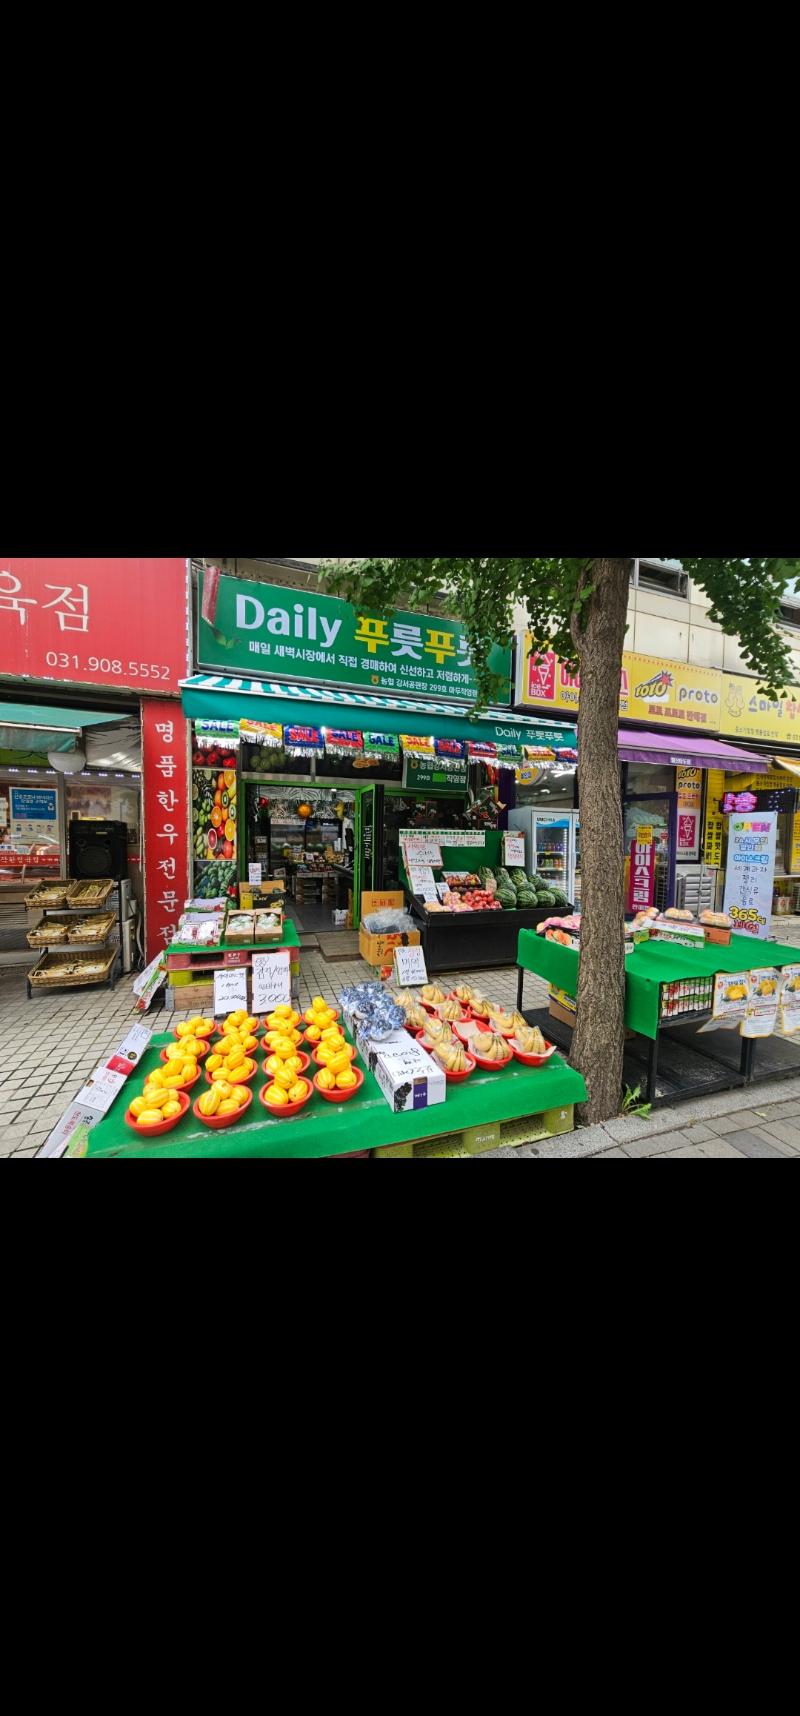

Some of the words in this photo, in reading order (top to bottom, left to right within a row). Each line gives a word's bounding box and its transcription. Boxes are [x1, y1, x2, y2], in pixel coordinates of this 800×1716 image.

[236, 593, 342, 648] Daily
[46, 651, 170, 680] 031.908.5552
[249, 640, 271, 656] 매일
[274, 644, 335, 665] 새벽시장에서
[338, 654, 358, 668] 직접
[361, 658, 397, 673] 경매하여
[400, 664, 434, 679] 신선하고
[381, 676, 395, 686] 농협
[530, 689, 546, 697] BOX
[679, 687, 719, 704] proto
[748, 694, 783, 718] 스마일
[785, 699, 800, 720] 찹
[201, 719, 235, 732] SALE
[288, 727, 320, 743] SALE
[369, 733, 395, 747] SALE
[495, 726, 521, 741] Daily
[526, 729, 564, 742] 푸릇푸릇
[678, 781, 701, 791] proto
[734, 853, 769, 865] 아이스크림
[735, 865, 768, 873] 세계과자
